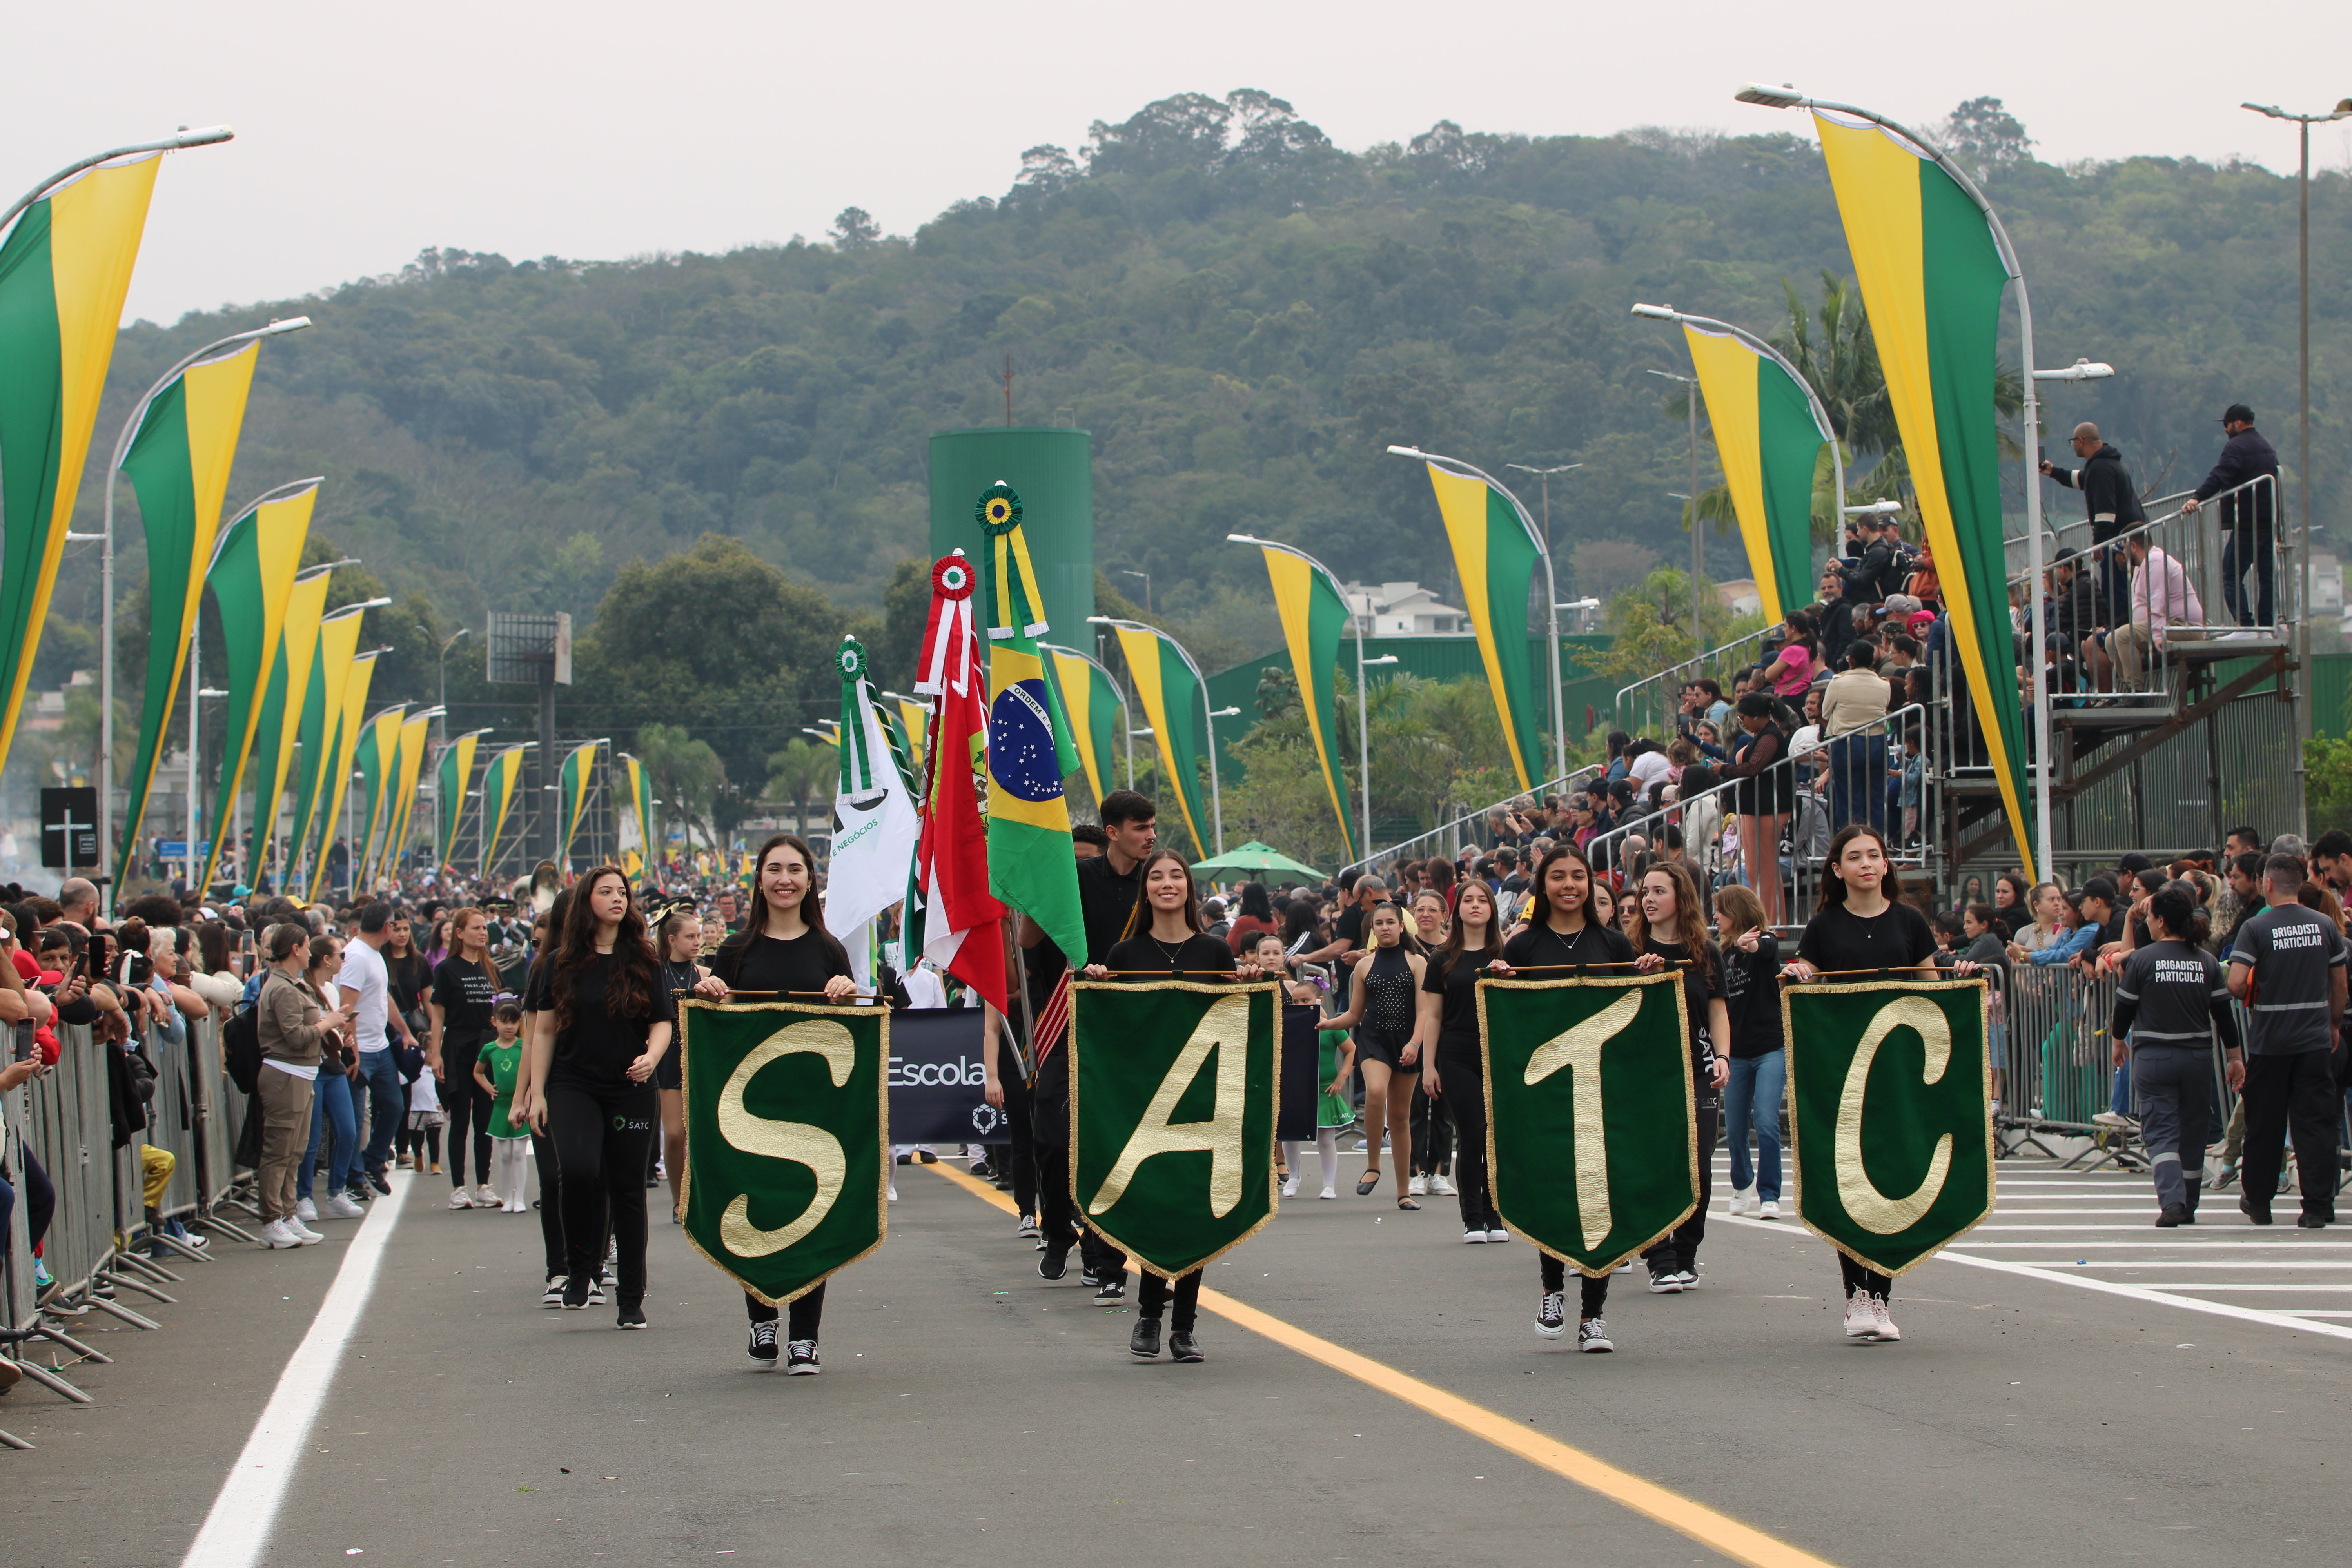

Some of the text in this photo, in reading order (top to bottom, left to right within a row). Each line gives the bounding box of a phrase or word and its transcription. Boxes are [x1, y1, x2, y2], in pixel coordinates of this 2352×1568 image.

[1014, 688, 1042, 715] ORDEM
[837, 818, 878, 851] NEGÓCIOS
[2272, 924, 2320, 938] BRIGADISTA
[2273, 935, 2322, 951] PARTICULAR
[2155, 960, 2203, 972] BRIGADISTA
[2155, 971, 2204, 983] PARTICULAR
[1728, 978, 1751, 988] ECIMENTO
[888, 1055, 987, 1086] Escola
[1089, 993, 1250, 1218] A
[1835, 996, 1953, 1234] C
[718, 1019, 855, 1258] S
